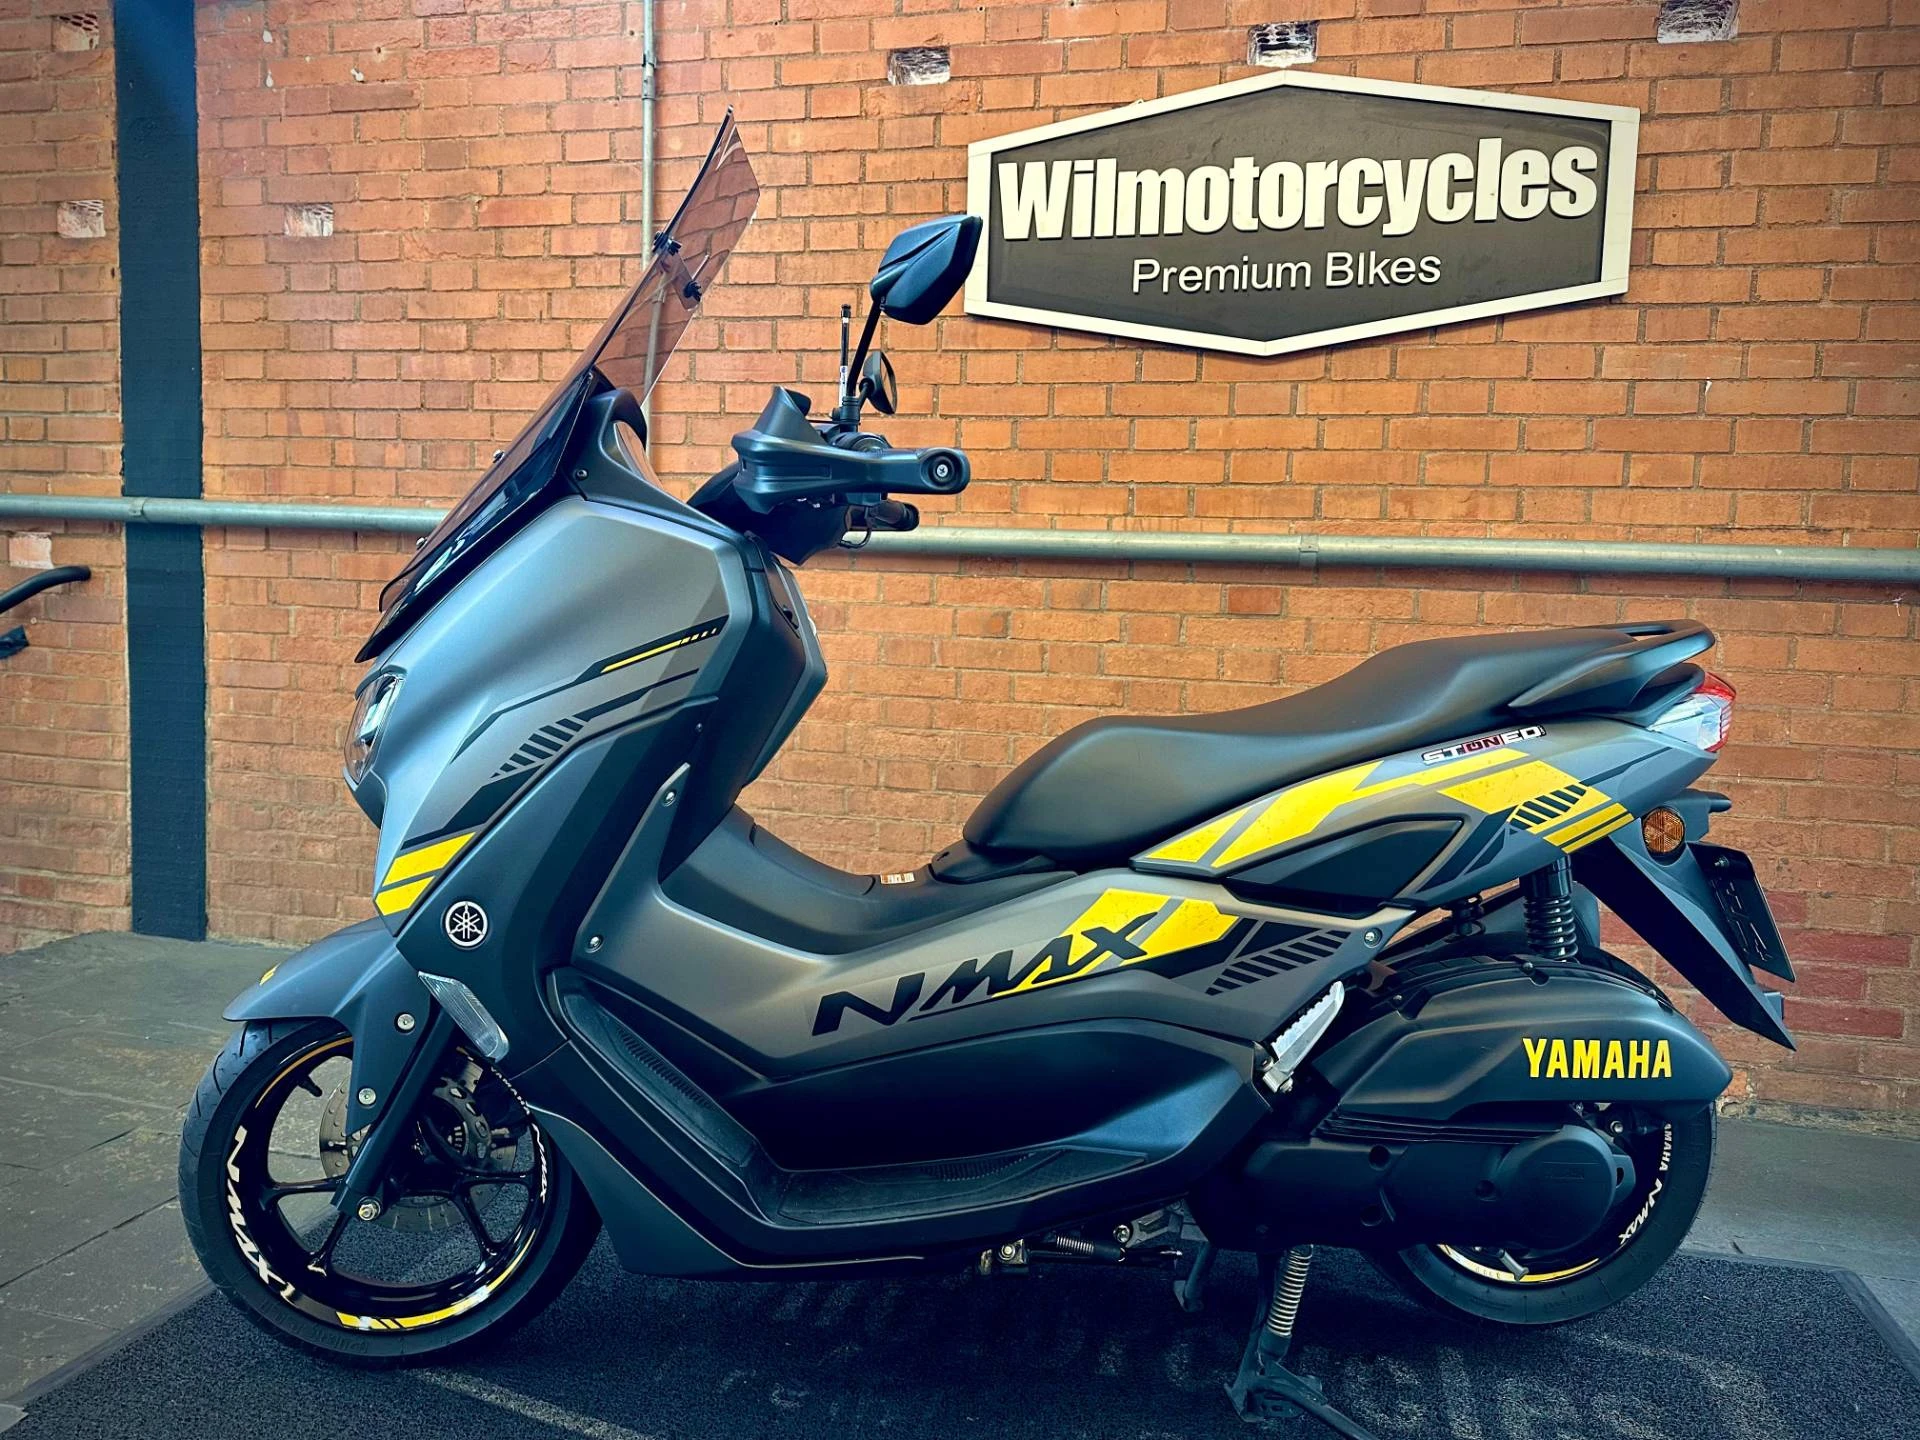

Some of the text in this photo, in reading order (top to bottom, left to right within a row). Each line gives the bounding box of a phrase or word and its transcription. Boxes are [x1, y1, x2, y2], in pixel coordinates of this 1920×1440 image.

[998, 137, 1599, 240] Wilmotorcycles
[1131, 256, 1313, 294] Premium
[812, 911, 1158, 1036] NMAX
[1522, 1037, 1672, 1079] YAMAHA
[1658, 1121, 1673, 1172] AMAHA
[226, 1125, 287, 1285] NMAX
